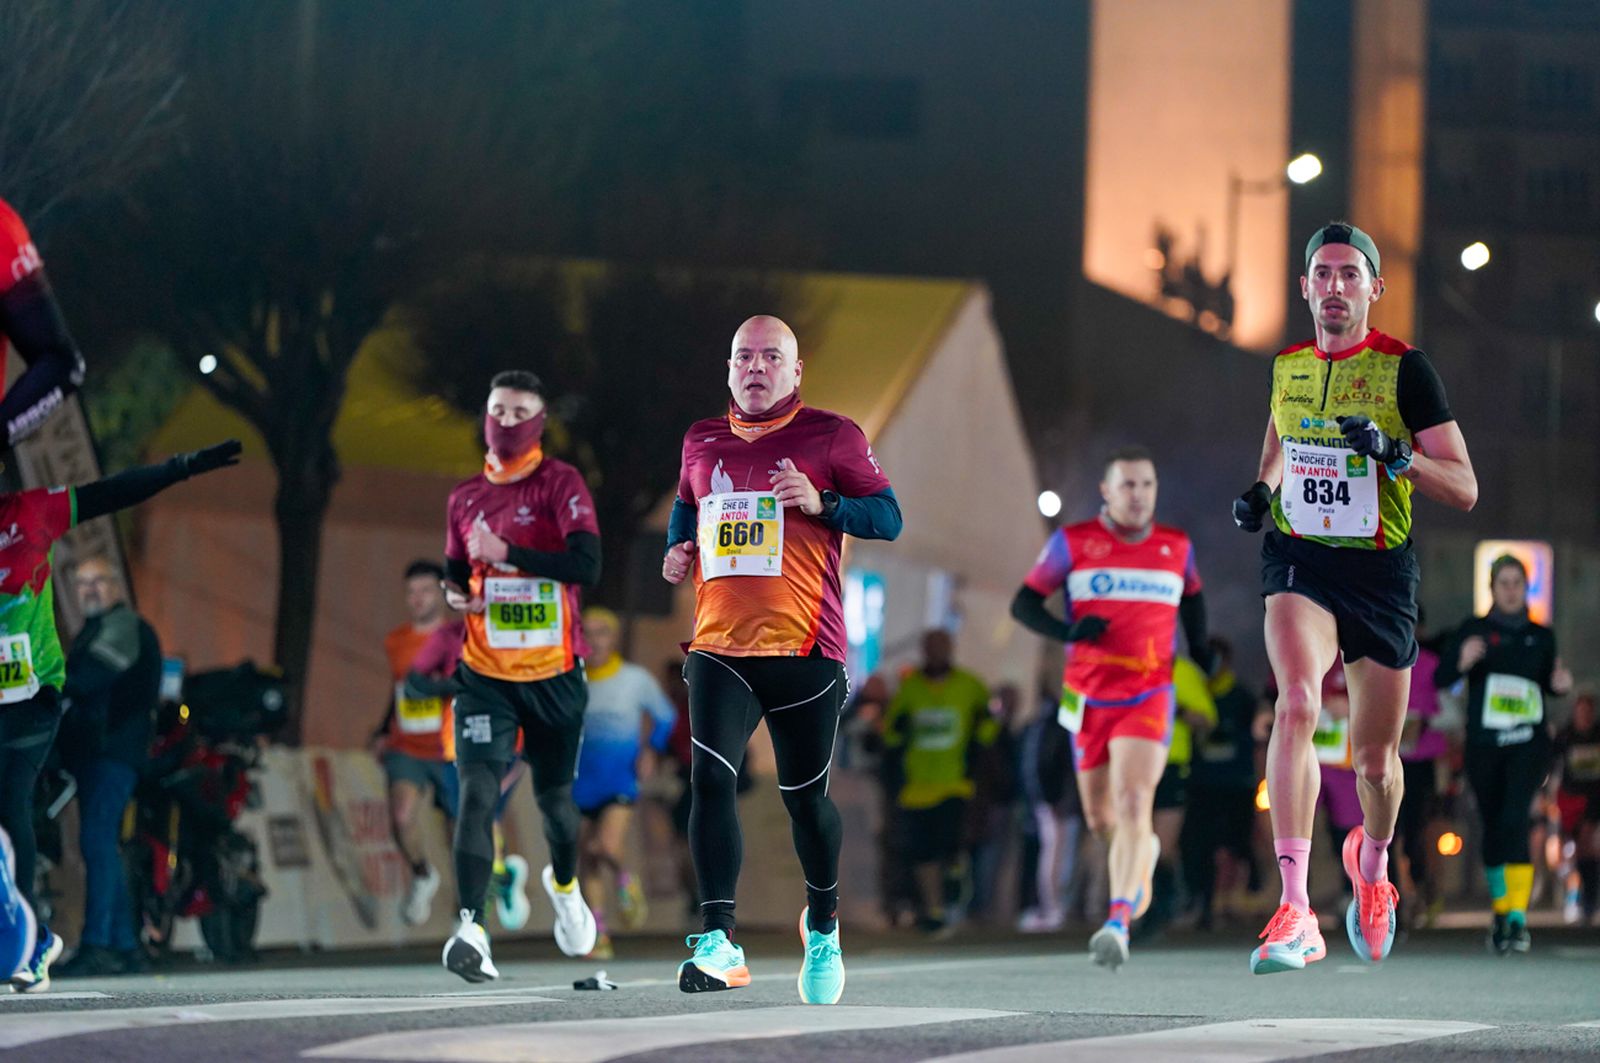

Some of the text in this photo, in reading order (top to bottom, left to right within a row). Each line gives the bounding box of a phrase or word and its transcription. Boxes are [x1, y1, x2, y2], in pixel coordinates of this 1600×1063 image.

[1301, 437, 1352, 449] HYUND
[1298, 455, 1337, 467] NOCHE DE
[1291, 464, 1306, 475] SAN
[1308, 465, 1338, 478] ANTÓN
[1303, 478, 1351, 506] 834
[738, 501, 749, 509] DE
[719, 521, 764, 547] 660
[500, 603, 546, 624] 6913
[0, 661, 24, 682] 72
